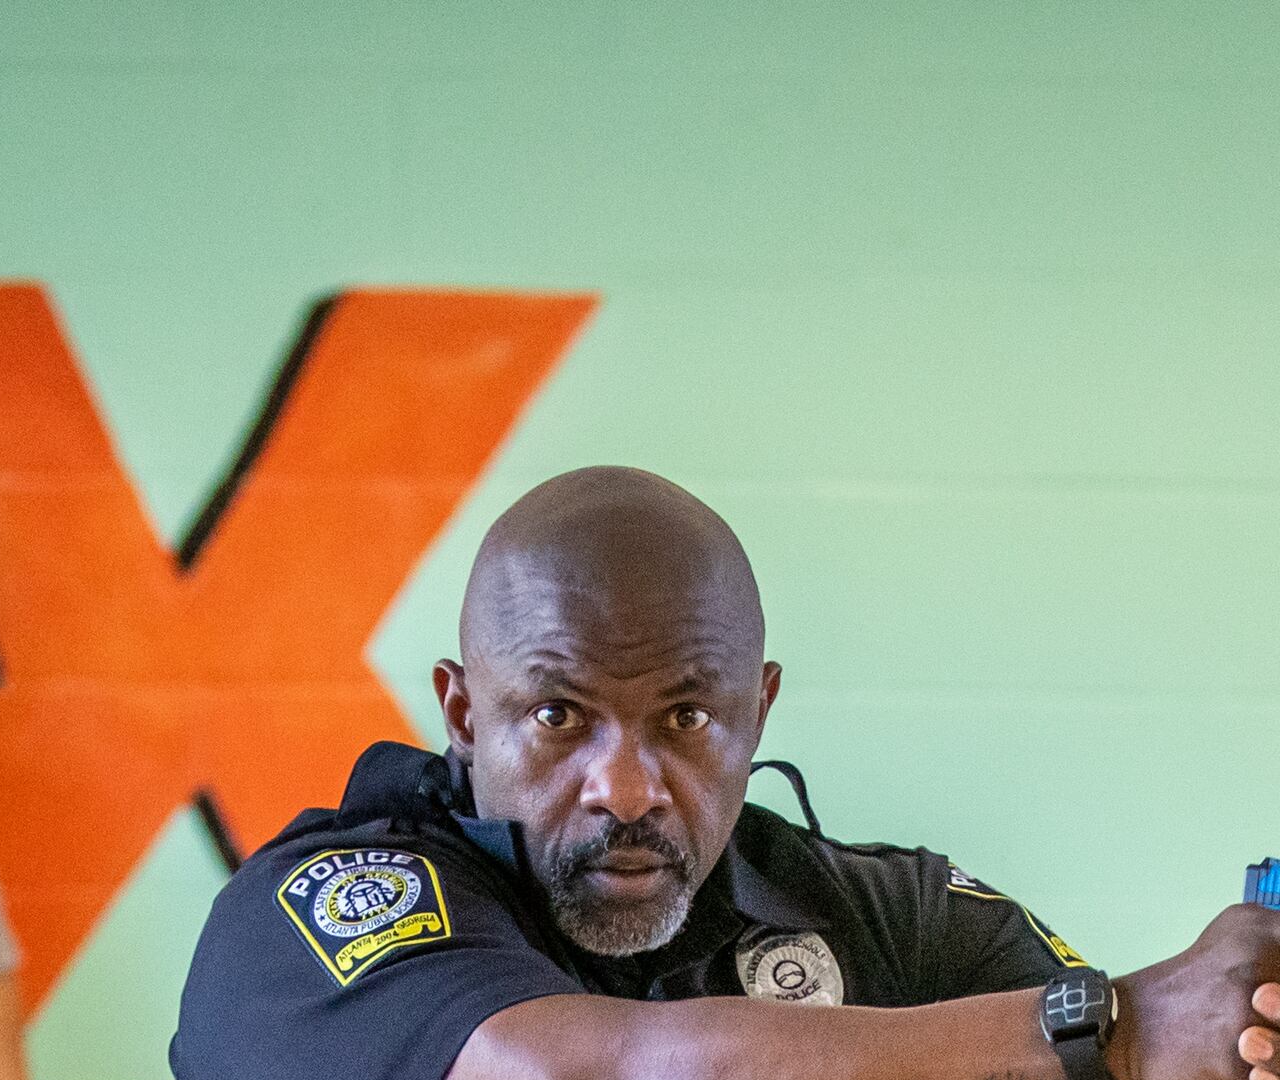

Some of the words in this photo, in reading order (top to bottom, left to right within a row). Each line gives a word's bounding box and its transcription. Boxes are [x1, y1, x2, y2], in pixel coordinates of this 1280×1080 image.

[288, 851, 414, 898] POLICE
[324, 922, 359, 937] ATLANTA
[361, 914, 395, 934] PUBLIC
[338, 936, 372, 962] ATLANTA
[396, 914, 436, 930] GEORGIA
